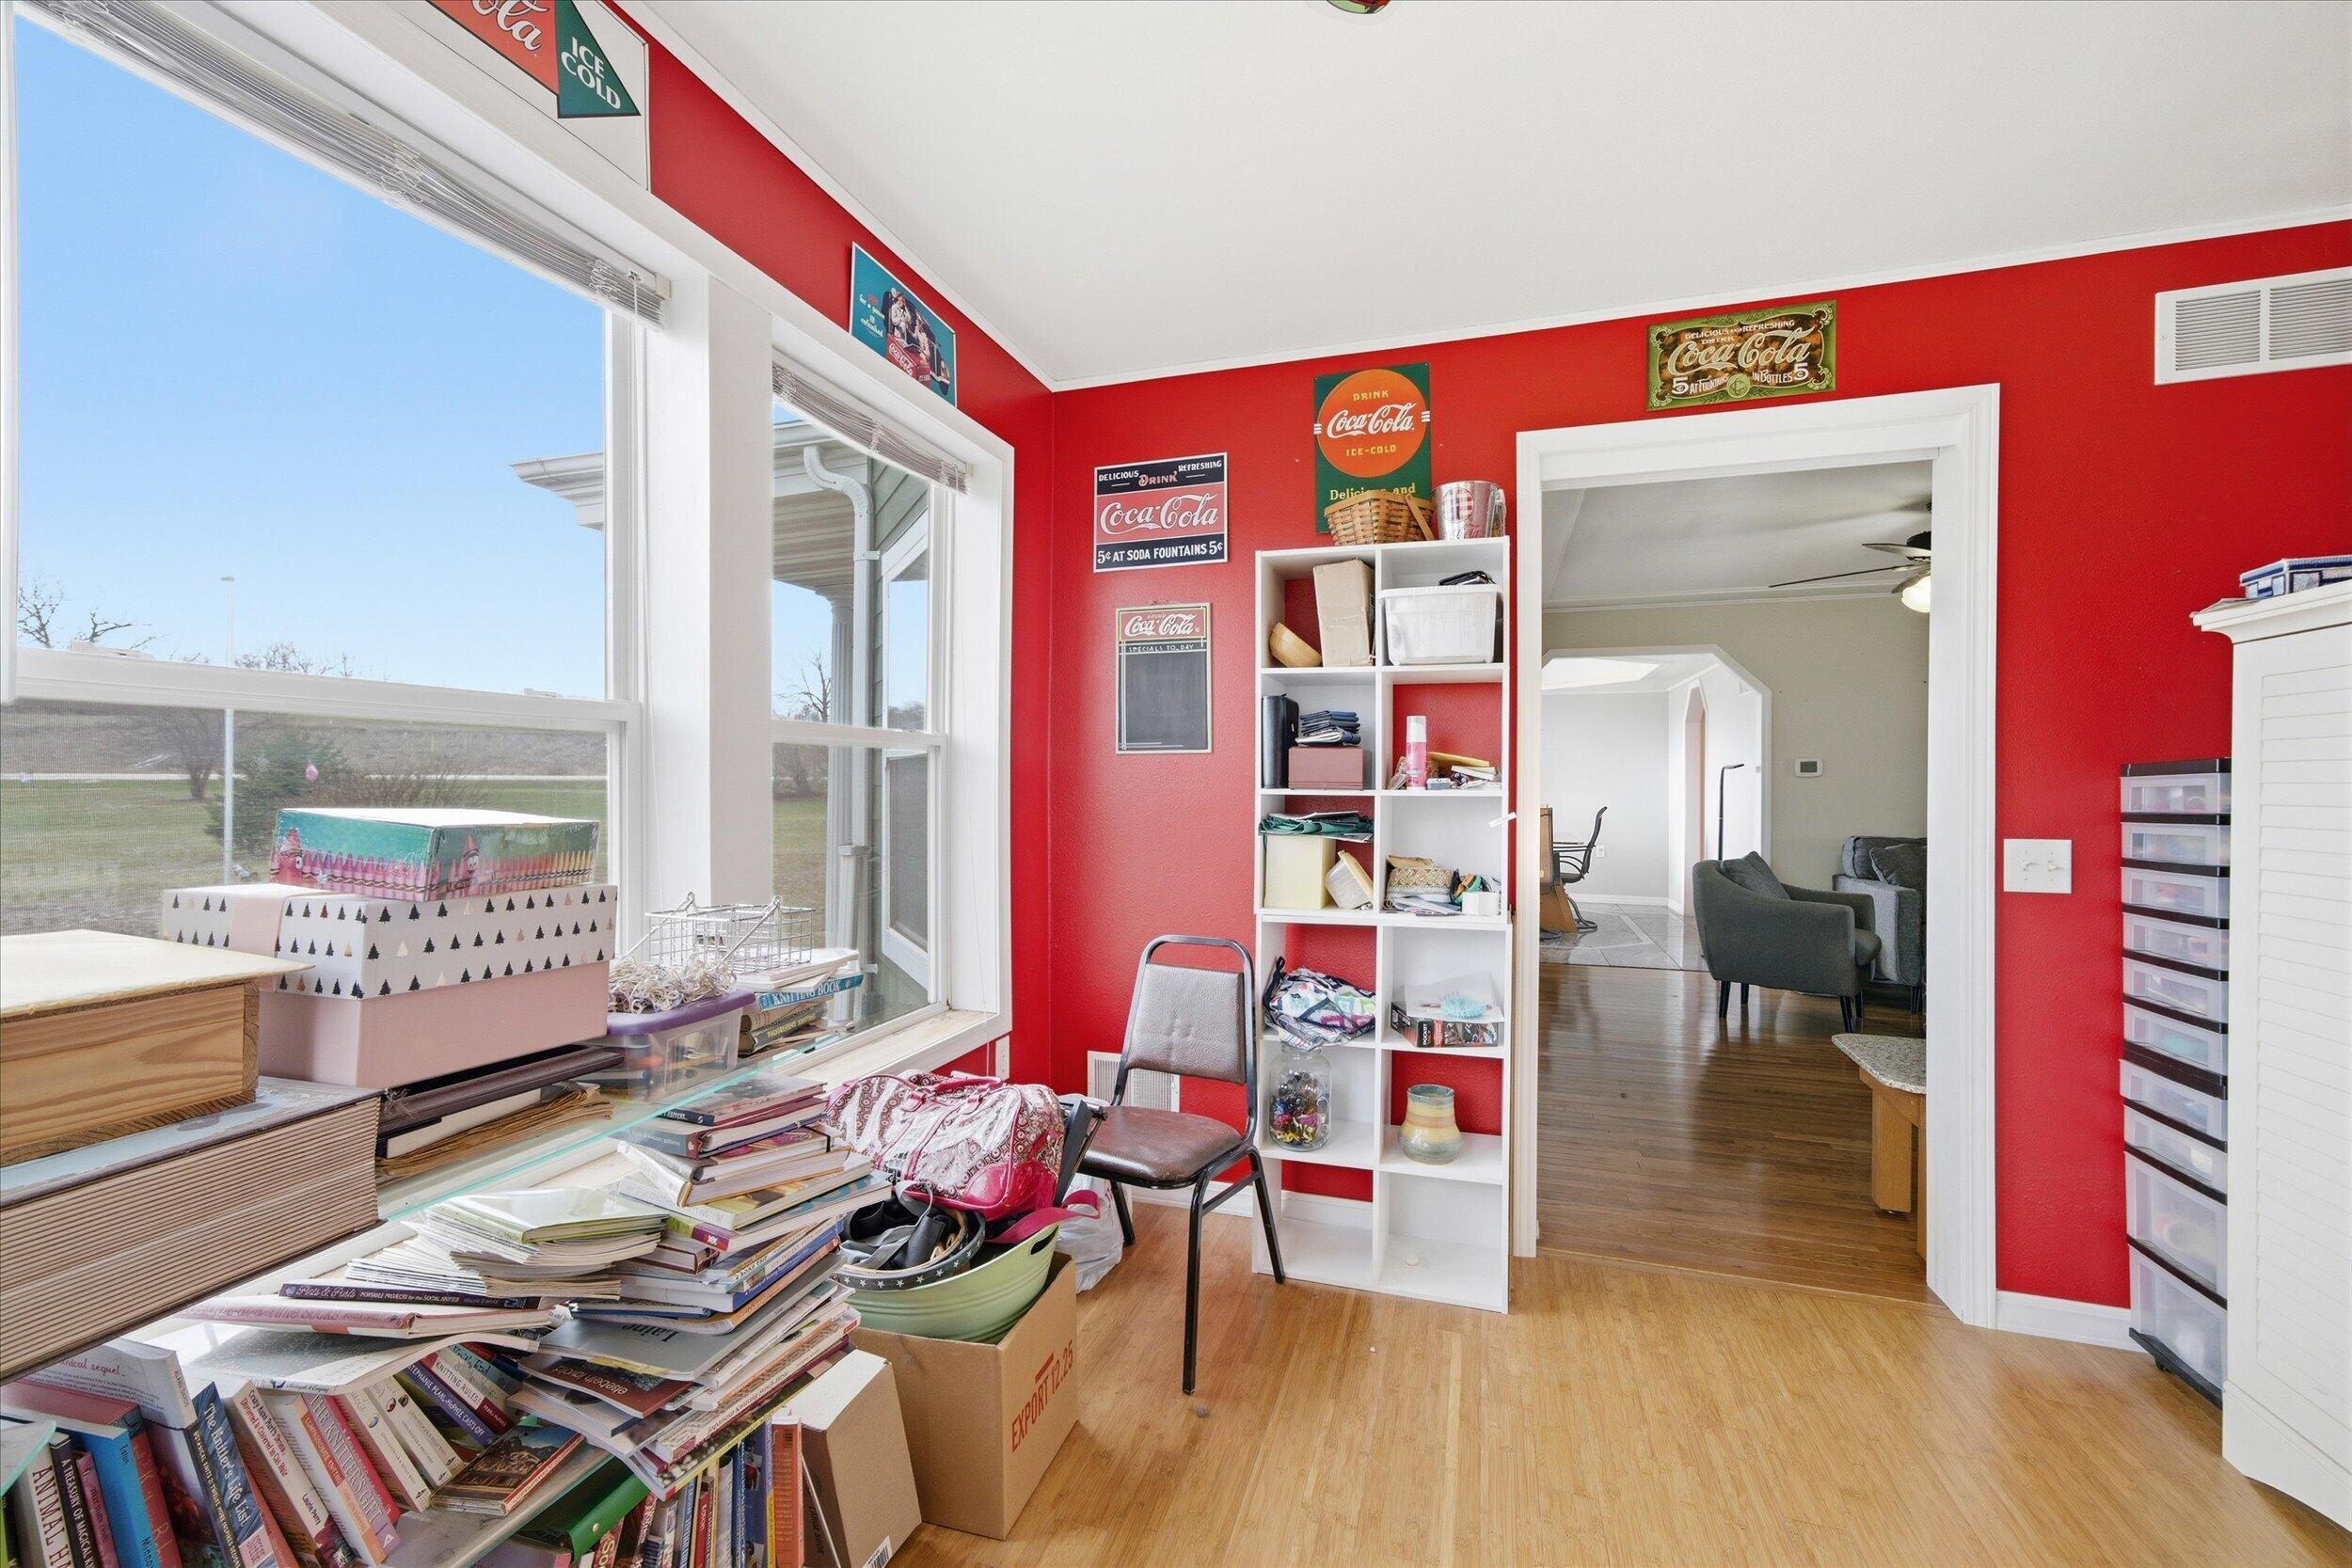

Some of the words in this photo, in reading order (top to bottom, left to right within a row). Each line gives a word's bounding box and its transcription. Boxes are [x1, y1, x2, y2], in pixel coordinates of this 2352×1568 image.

[571, 37, 605, 79] ICE
[561, 52, 621, 110] COLD
[1685, 328, 1729, 340] DELICIOUS
[1742, 320, 1795, 332] REFRESHING
[1667, 325, 1816, 376] Coca-Cola
[1353, 389, 1390, 402] DRINK
[1327, 402, 1417, 439] Coca-Cola
[1345, 444, 1397, 457] ICE-COLD
[1098, 470, 1139, 482] DELICIOUS
[1138, 471, 1178, 487] DRINK
[1178, 460, 1222, 472] REFRESHING
[1392, 483, 1416, 495] and
[1100, 492, 1220, 535] Coca-Cola
[1097, 550, 1111, 564] 5¢
[1112, 550, 1125, 562] AT
[1126, 548, 1151, 562] SODA
[1153, 543, 1208, 559] FOUNTAINS
[1209, 540, 1224, 555] 5¢
[1124, 613, 1197, 637] Coca-Cola
[817, 983, 840, 995] BOOK
[436, 1362, 462, 1387] KNITTING
[248, 1389, 260, 1409] Crazy
[407, 1364, 434, 1389] STEPHANIE
[461, 1414, 477, 1433] CASTS
[203, 1402, 217, 1430] The
[1011, 1375, 1049, 1453] EXPORT
[61, 1458, 72, 1467] A
[211, 1426, 234, 1481] Knitter's
[63, 1465, 81, 1509] TREASURY
[227, 1478, 244, 1505] Life
[32, 1465, 65, 1546] ANIMAL
[72, 1508, 84, 1521] OF
[234, 1500, 251, 1528] List
[75, 1519, 92, 1559] MAGICAL
